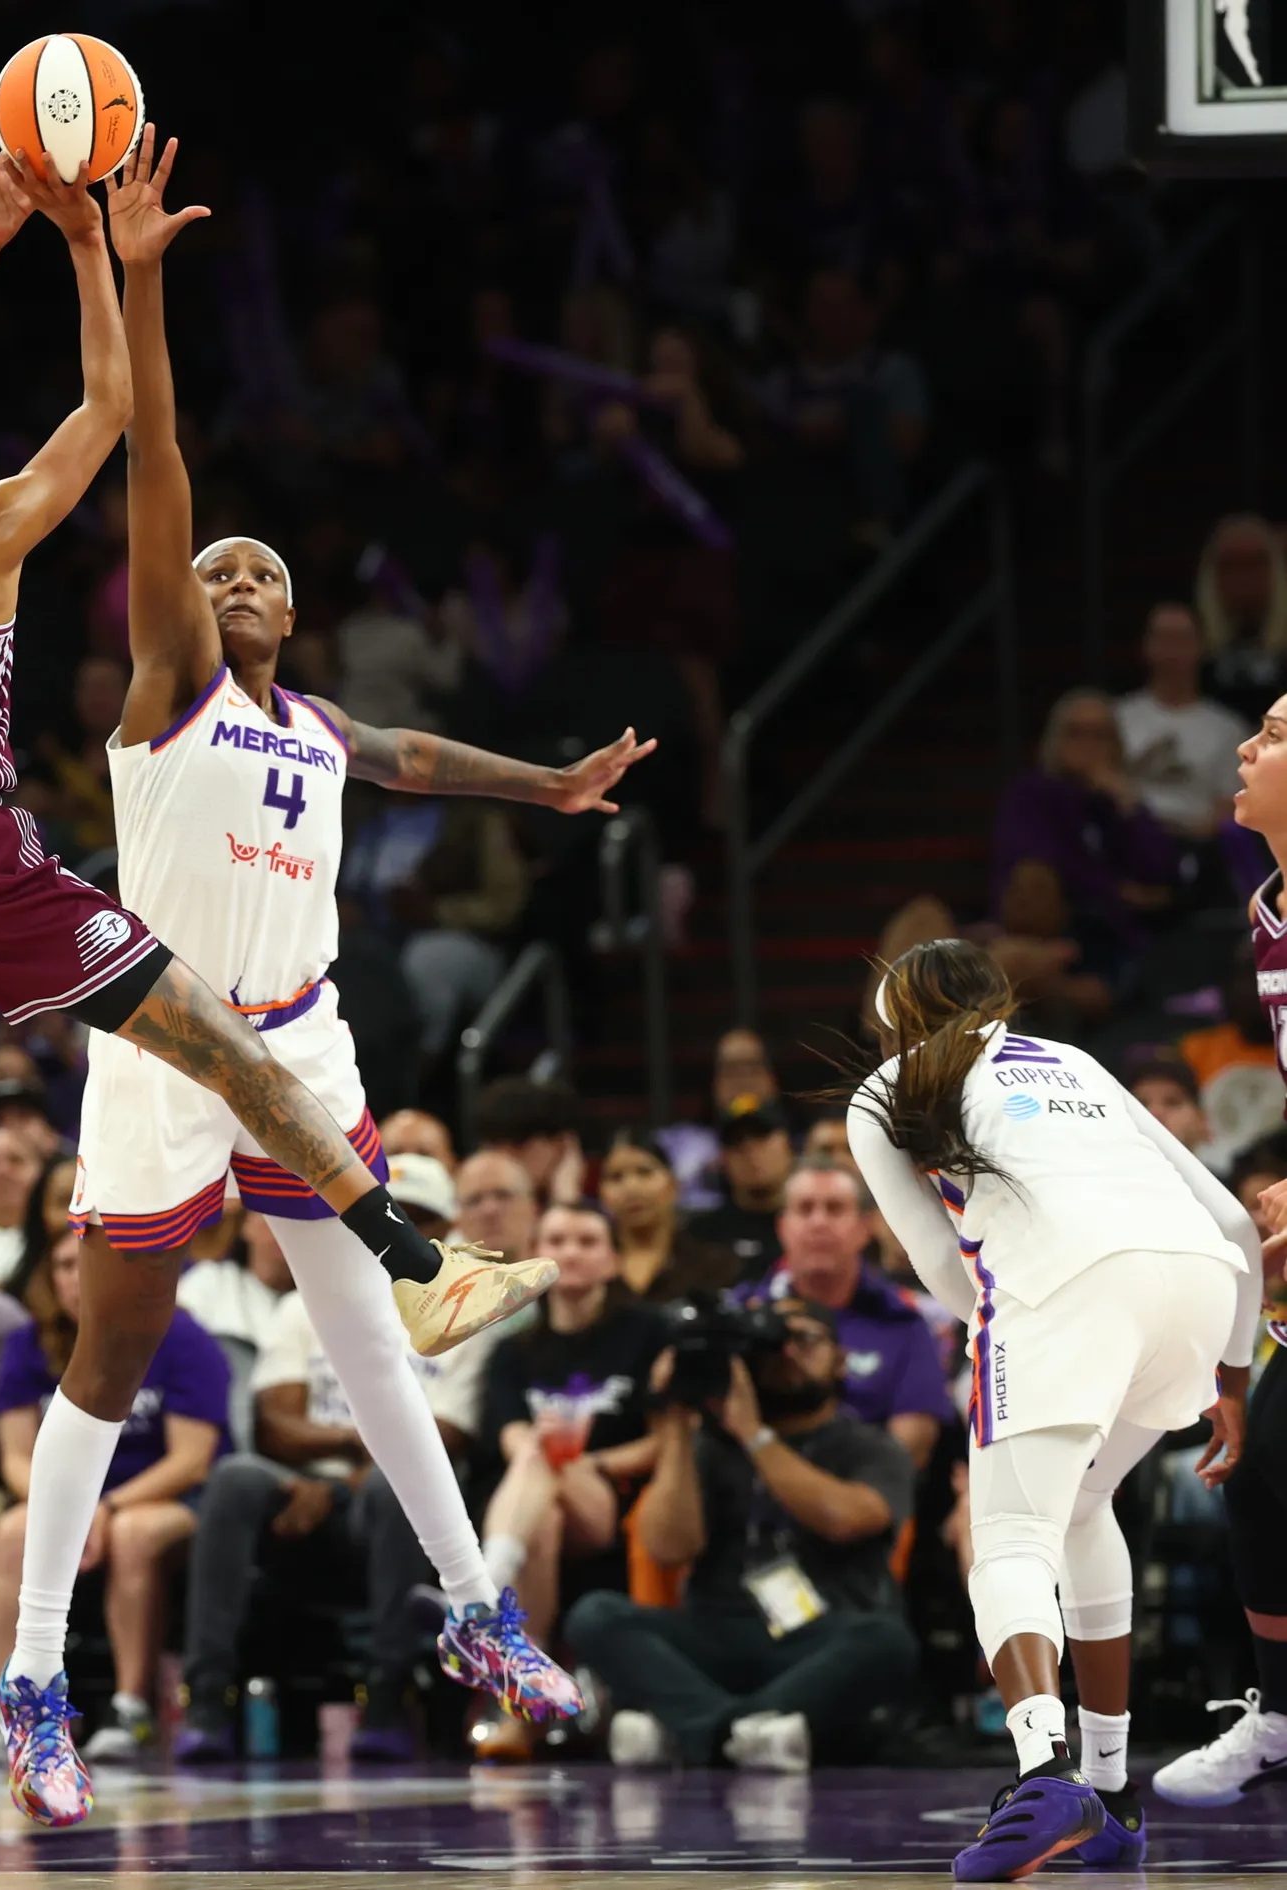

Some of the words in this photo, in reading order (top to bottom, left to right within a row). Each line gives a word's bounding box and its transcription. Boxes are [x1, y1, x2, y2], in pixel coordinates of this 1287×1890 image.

[210, 720, 338, 775] MERCURY
[262, 767, 307, 830] 4
[995, 1067, 1084, 1090] COPPER
[1048, 1099, 1107, 1119] AT&T
[994, 1340, 1008, 1421] PHOENIX
